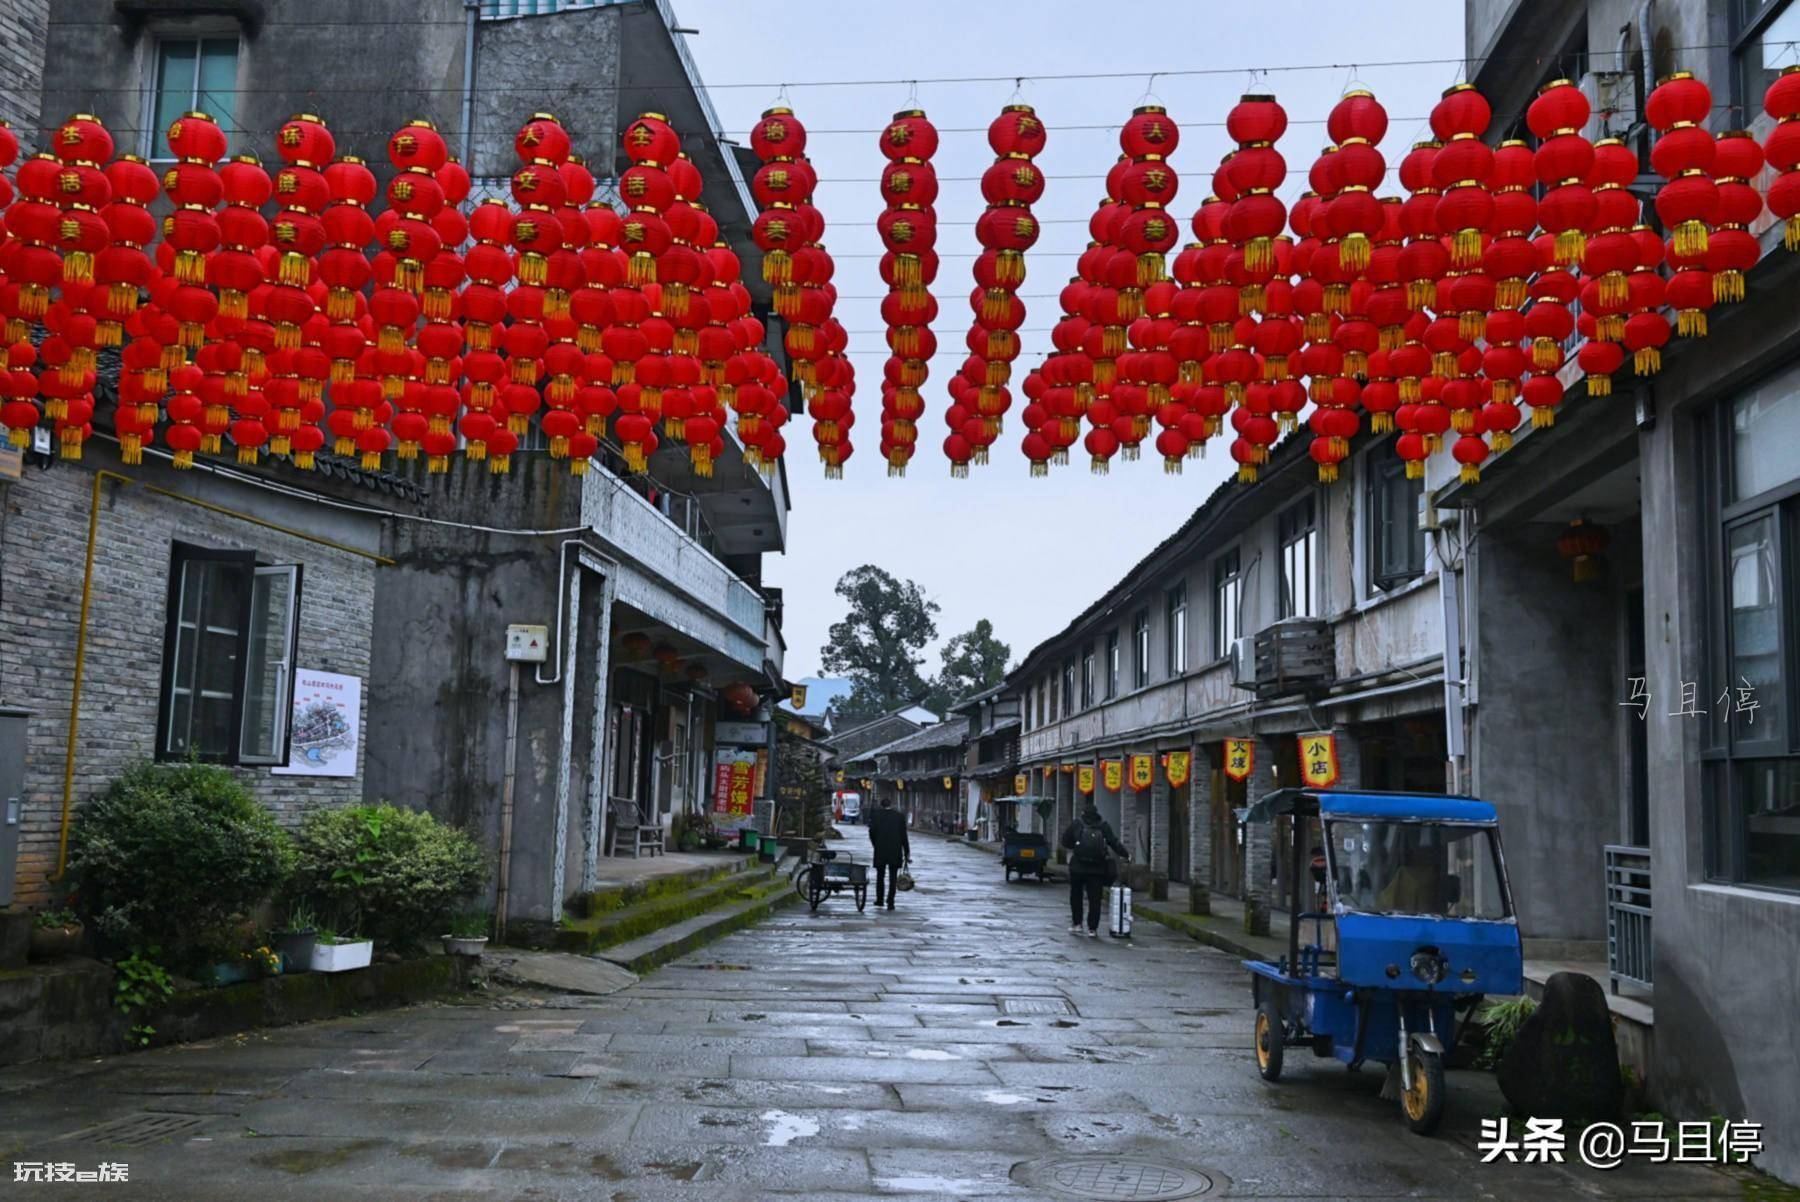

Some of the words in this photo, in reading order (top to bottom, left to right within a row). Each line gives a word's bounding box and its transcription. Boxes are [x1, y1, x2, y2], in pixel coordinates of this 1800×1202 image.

[60, 126, 81, 240] 生活美
[276, 126, 302, 243] 环境美
[389, 134, 414, 249] 产业美
[517, 126, 540, 244] 人文美
[625, 125, 650, 242] 生活美
[766, 122, 788, 241] 治理美
[890, 125, 912, 242] 环境美
[1016, 117, 1038, 237] 产业美
[1146, 123, 1166, 240] 人文美
[1308, 742, 1328, 775] 小店
